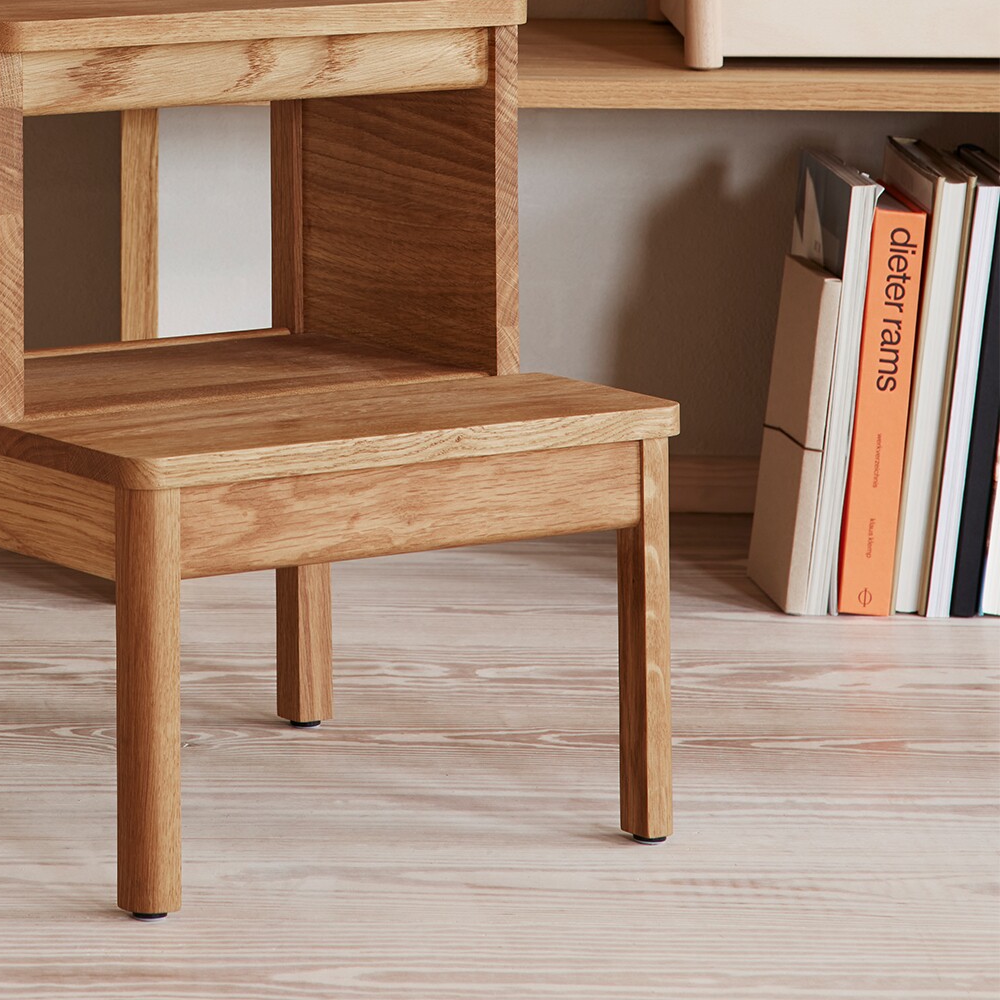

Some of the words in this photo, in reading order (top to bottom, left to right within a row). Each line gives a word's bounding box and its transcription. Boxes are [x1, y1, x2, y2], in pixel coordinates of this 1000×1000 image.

[885, 227, 917, 313] dieter
[876, 318, 902, 392] rams
[873, 433, 882, 488] werkverzeichnis
